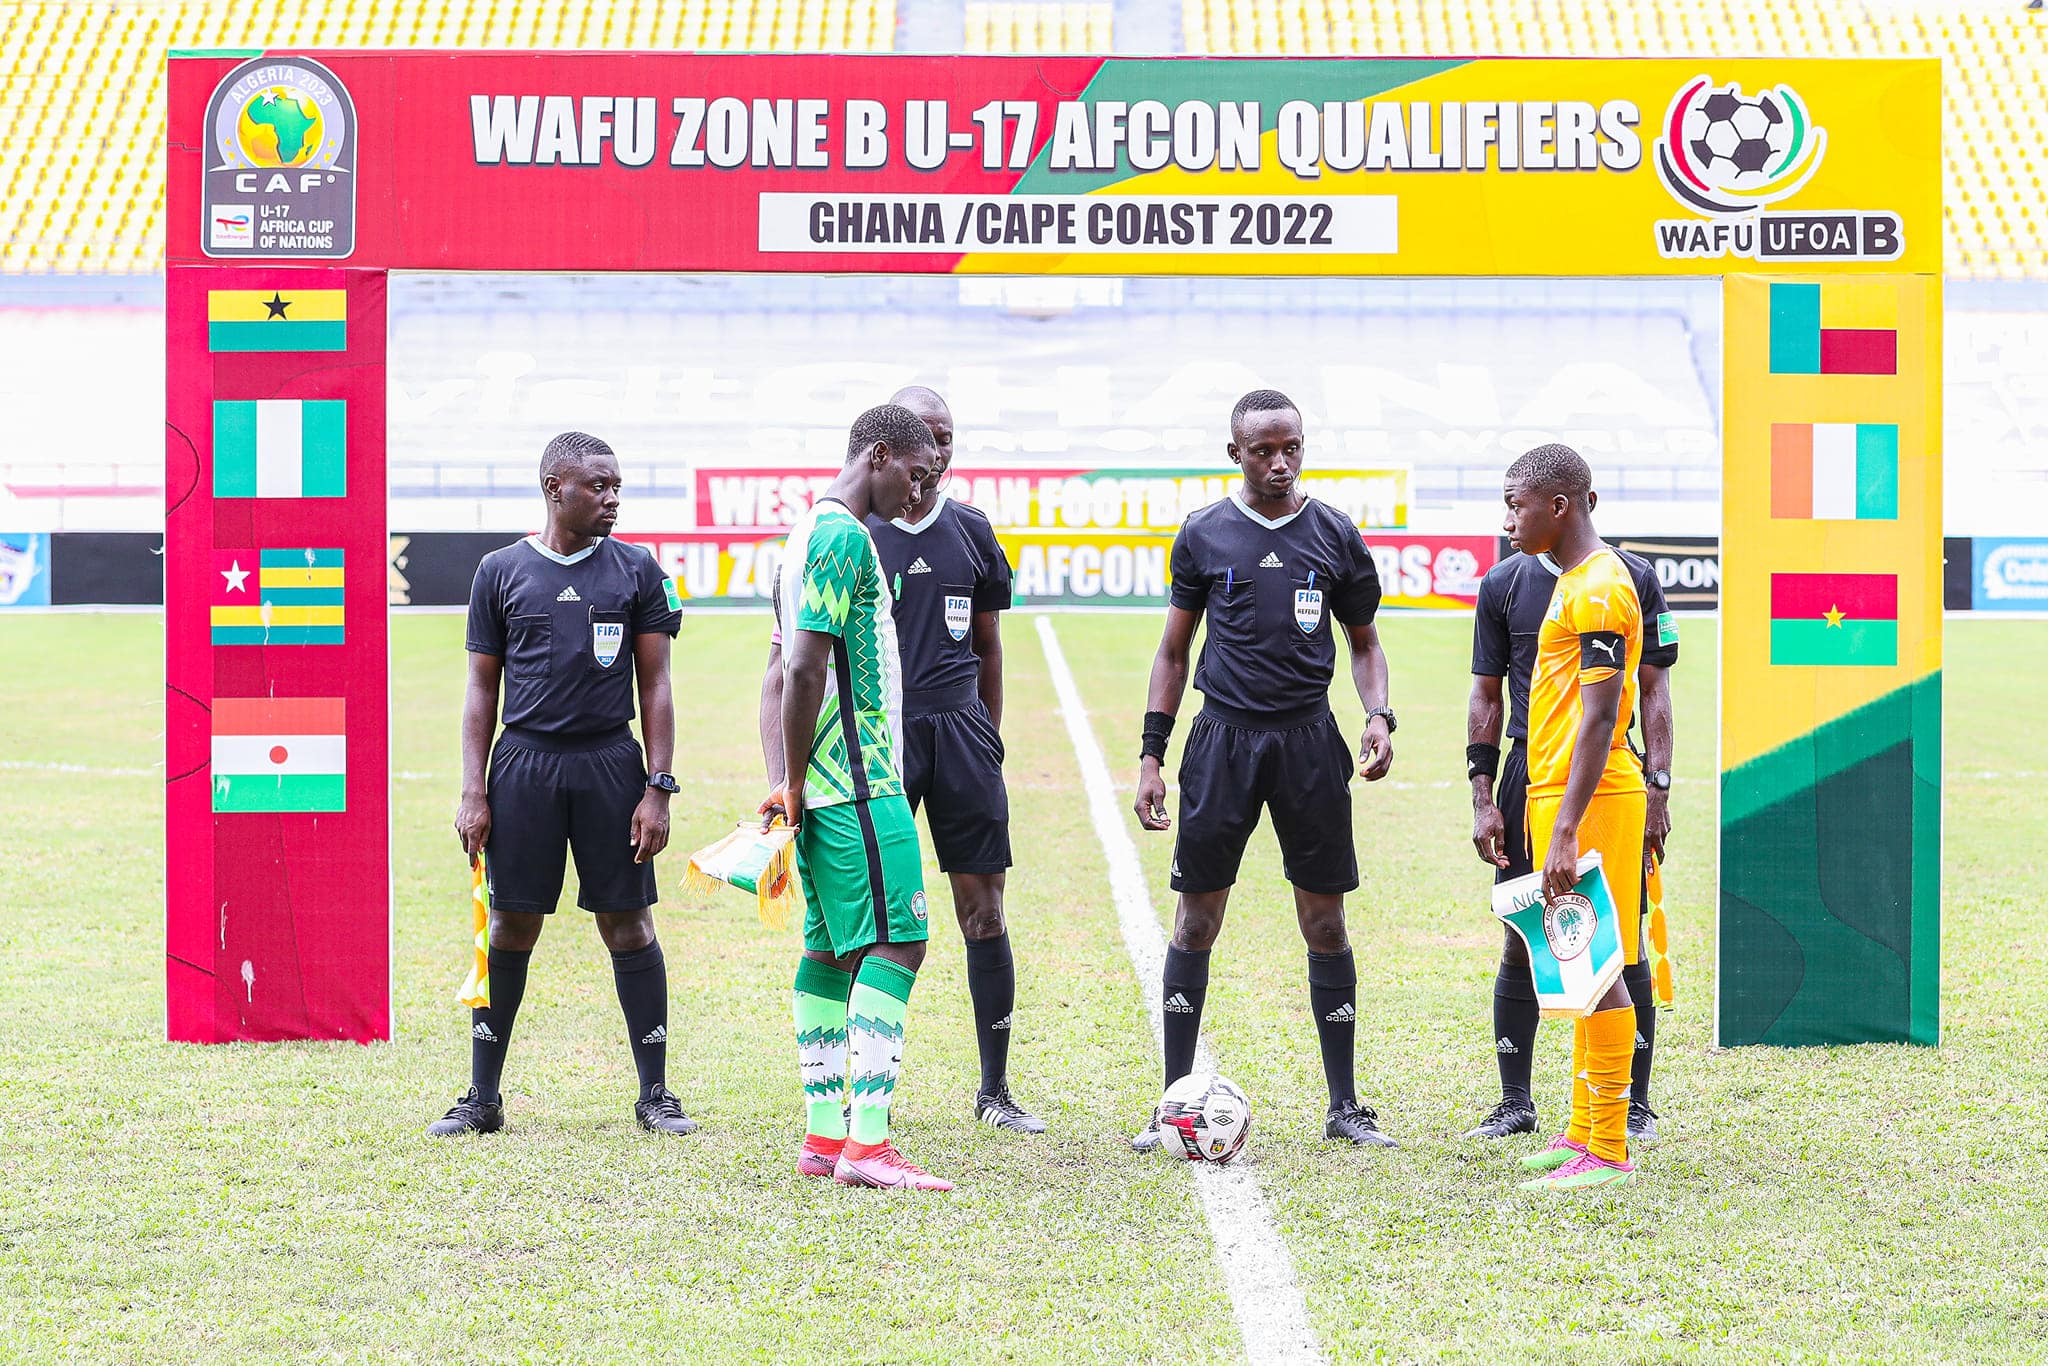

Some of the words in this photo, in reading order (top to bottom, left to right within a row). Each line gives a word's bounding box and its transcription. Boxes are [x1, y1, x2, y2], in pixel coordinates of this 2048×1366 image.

[230, 67, 294, 105] ALGERIA
[300, 73, 334, 106] 2023
[470, 94, 657, 166] WAFU
[670, 97, 829, 168] ZONE
[844, 98, 889, 169] B
[904, 99, 1039, 169] U-17
[1048, 99, 1260, 171] AFCON
[1276, 100, 1642, 178] QUALIFIERS
[235, 174, 322, 193] CAF
[260, 205, 290, 217] U-17
[260, 220, 305, 233] AFRICA
[308, 220, 334, 233] CUP
[808, 202, 947, 245] GHANA
[1088, 203, 1220, 245] COAST
[1230, 203, 1333, 245] 2022
[260, 236, 276, 248] OF
[279, 236, 333, 249] NATIONS
[1660, 224, 1753, 252] WAFU
[1768, 222, 1851, 251] UFOA
[1862, 216, 1899, 255] B
[1014, 544, 1166, 597] AFCON
[948, 599, 969, 610] FIFA
[1298, 592, 1321, 603] FIFA
[597, 625, 620, 636] FIFA
